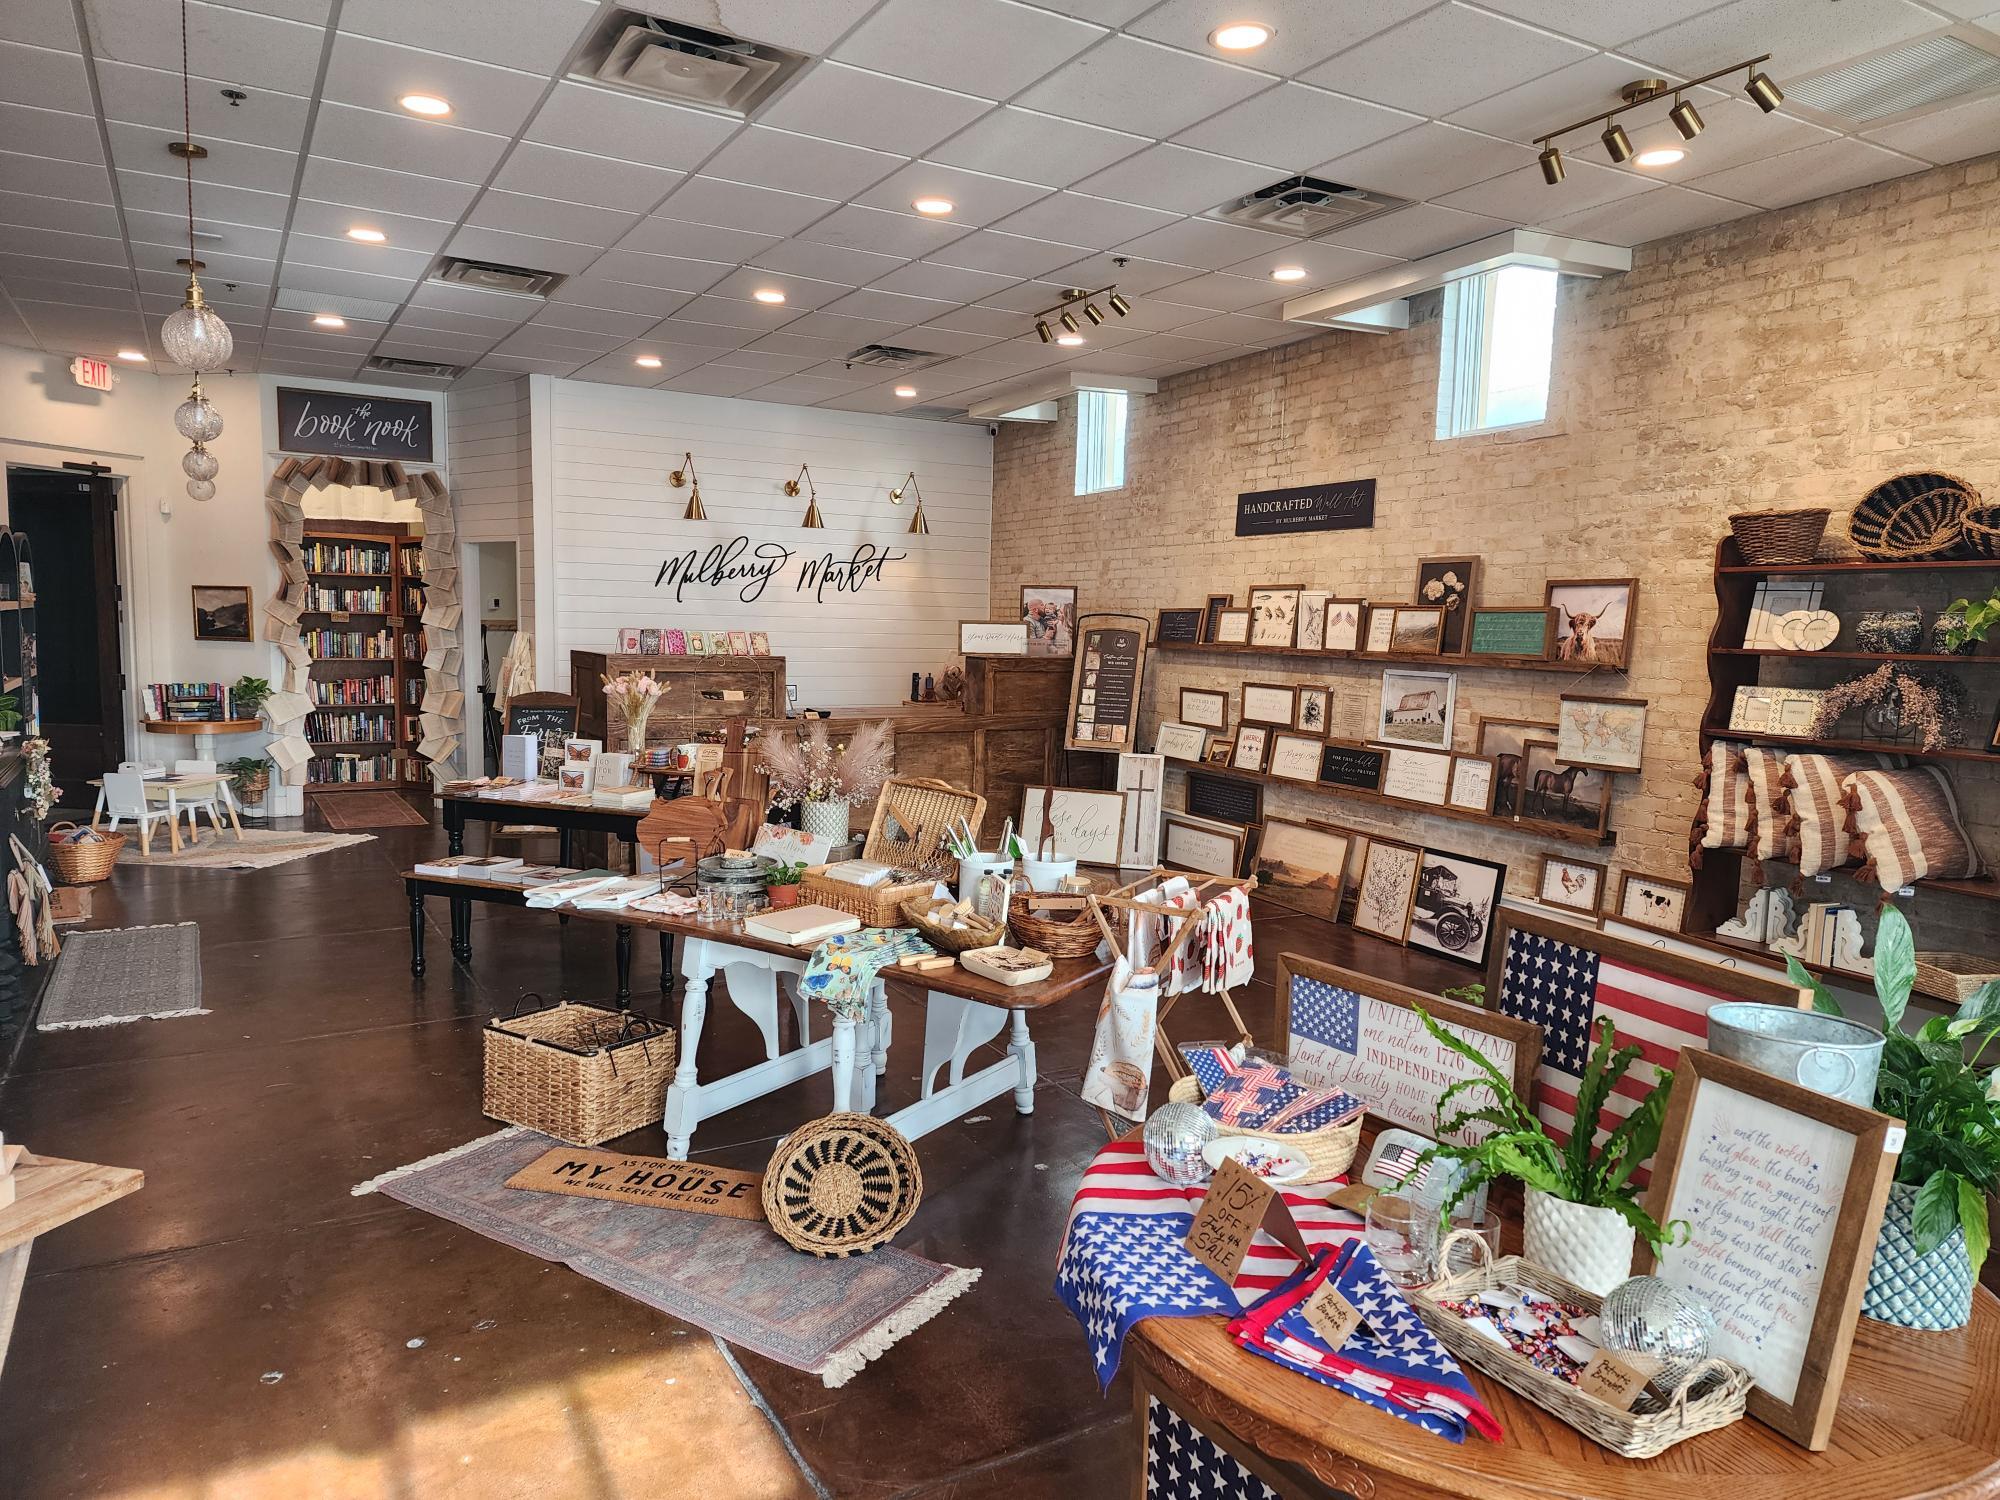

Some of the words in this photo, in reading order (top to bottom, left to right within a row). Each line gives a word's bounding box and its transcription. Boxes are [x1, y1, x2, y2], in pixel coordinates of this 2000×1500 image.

[83, 359, 107, 388] EXIT
[294, 401, 356, 442] book
[364, 415, 419, 448] nook
[351, 402, 372, 420] the
[1244, 497, 1313, 515] HANDCRAFTED
[1314, 492, 1343, 513] Wall
[1343, 487, 1366, 511] Art
[1308, 514, 1328, 522] MARKET
[655, 536, 796, 603] Mulberry
[797, 543, 907, 604] Market
[517, 714, 539, 726] FROM
[546, 714, 565, 725] THE
[1243, 735, 1262, 744] AMERICA
[1356, 768, 1376, 776] PRAYED
[1071, 803, 1114, 855] days
[1363, 1026, 1384, 1043] one
[1387, 1031, 1429, 1059] nation
[1436, 1046, 1464, 1072] 1776
[1368, 1000, 1424, 1033] UNITED
[1461, 1028, 1514, 1062] STAND
[1290, 1038, 1327, 1067] Land
[1327, 1054, 1341, 1079] of
[1340, 1057, 1390, 1101] Liberty
[1395, 1080, 1428, 1104] HOME
[1387, 1098, 1426, 1126] freedom
[1733, 1128, 1758, 1142] and
[1755, 1132, 1772, 1150] the
[1775, 1144, 1811, 1167] rockets
[552, 1160, 616, 1180] MY
[622, 1169, 756, 1199] HOUSE
[619, 1160, 638, 1168] AS
[640, 1161, 666, 1171] FOR
[668, 1163, 687, 1173] ME
[690, 1167, 714, 1177] AND
[1699, 1148, 1741, 1183] bursting
[1742, 1174, 1754, 1185] in
[1768, 1189, 1800, 1204] gave
[1799, 1199, 1837, 1223] proof
[1716, 1142, 1736, 1155] red
[1764, 1159, 1782, 1177] the
[1784, 1167, 1820, 1194] bombs
[563, 1178, 584, 1187] WE
[585, 1179, 613, 1191] WILL
[615, 1185, 662, 1198] SERVE
[661, 1191, 684, 1201] THE
[685, 1195, 720, 1206] LORD
[1221, 1177, 1260, 1211] 15%
[1701, 1172, 1742, 1202] through
[1741, 1190, 1759, 1209] the
[1793, 1214, 1821, 1238] that
[1200, 1214, 1226, 1241] July
[1218, 1207, 1241, 1229] OFF
[1711, 1200, 1732, 1225] flag
[1734, 1215, 1756, 1232] was
[1758, 1225, 1787, 1244] still
[1194, 1232, 1235, 1267] SALE
[1710, 1225, 1729, 1245] say
[1731, 1233, 1752, 1253] does
[1753, 1243, 1779, 1264] that
[1777, 1257, 1802, 1278] star
[1724, 1250, 1762, 1281] banner
[1756, 1277, 1783, 1290] yet
[1699, 1261, 1719, 1282] the
[1718, 1271, 1747, 1294] land
[1743, 1286, 1760, 1305] of
[1755, 1292, 1775, 1312] the
[1773, 1302, 1798, 1324] free
[1694, 1286, 1719, 1301] and
[1714, 1292, 1733, 1313] the
[1732, 1303, 1760, 1329] home
[1760, 1321, 1777, 1339] of
[1723, 1316, 1753, 1345] brave
